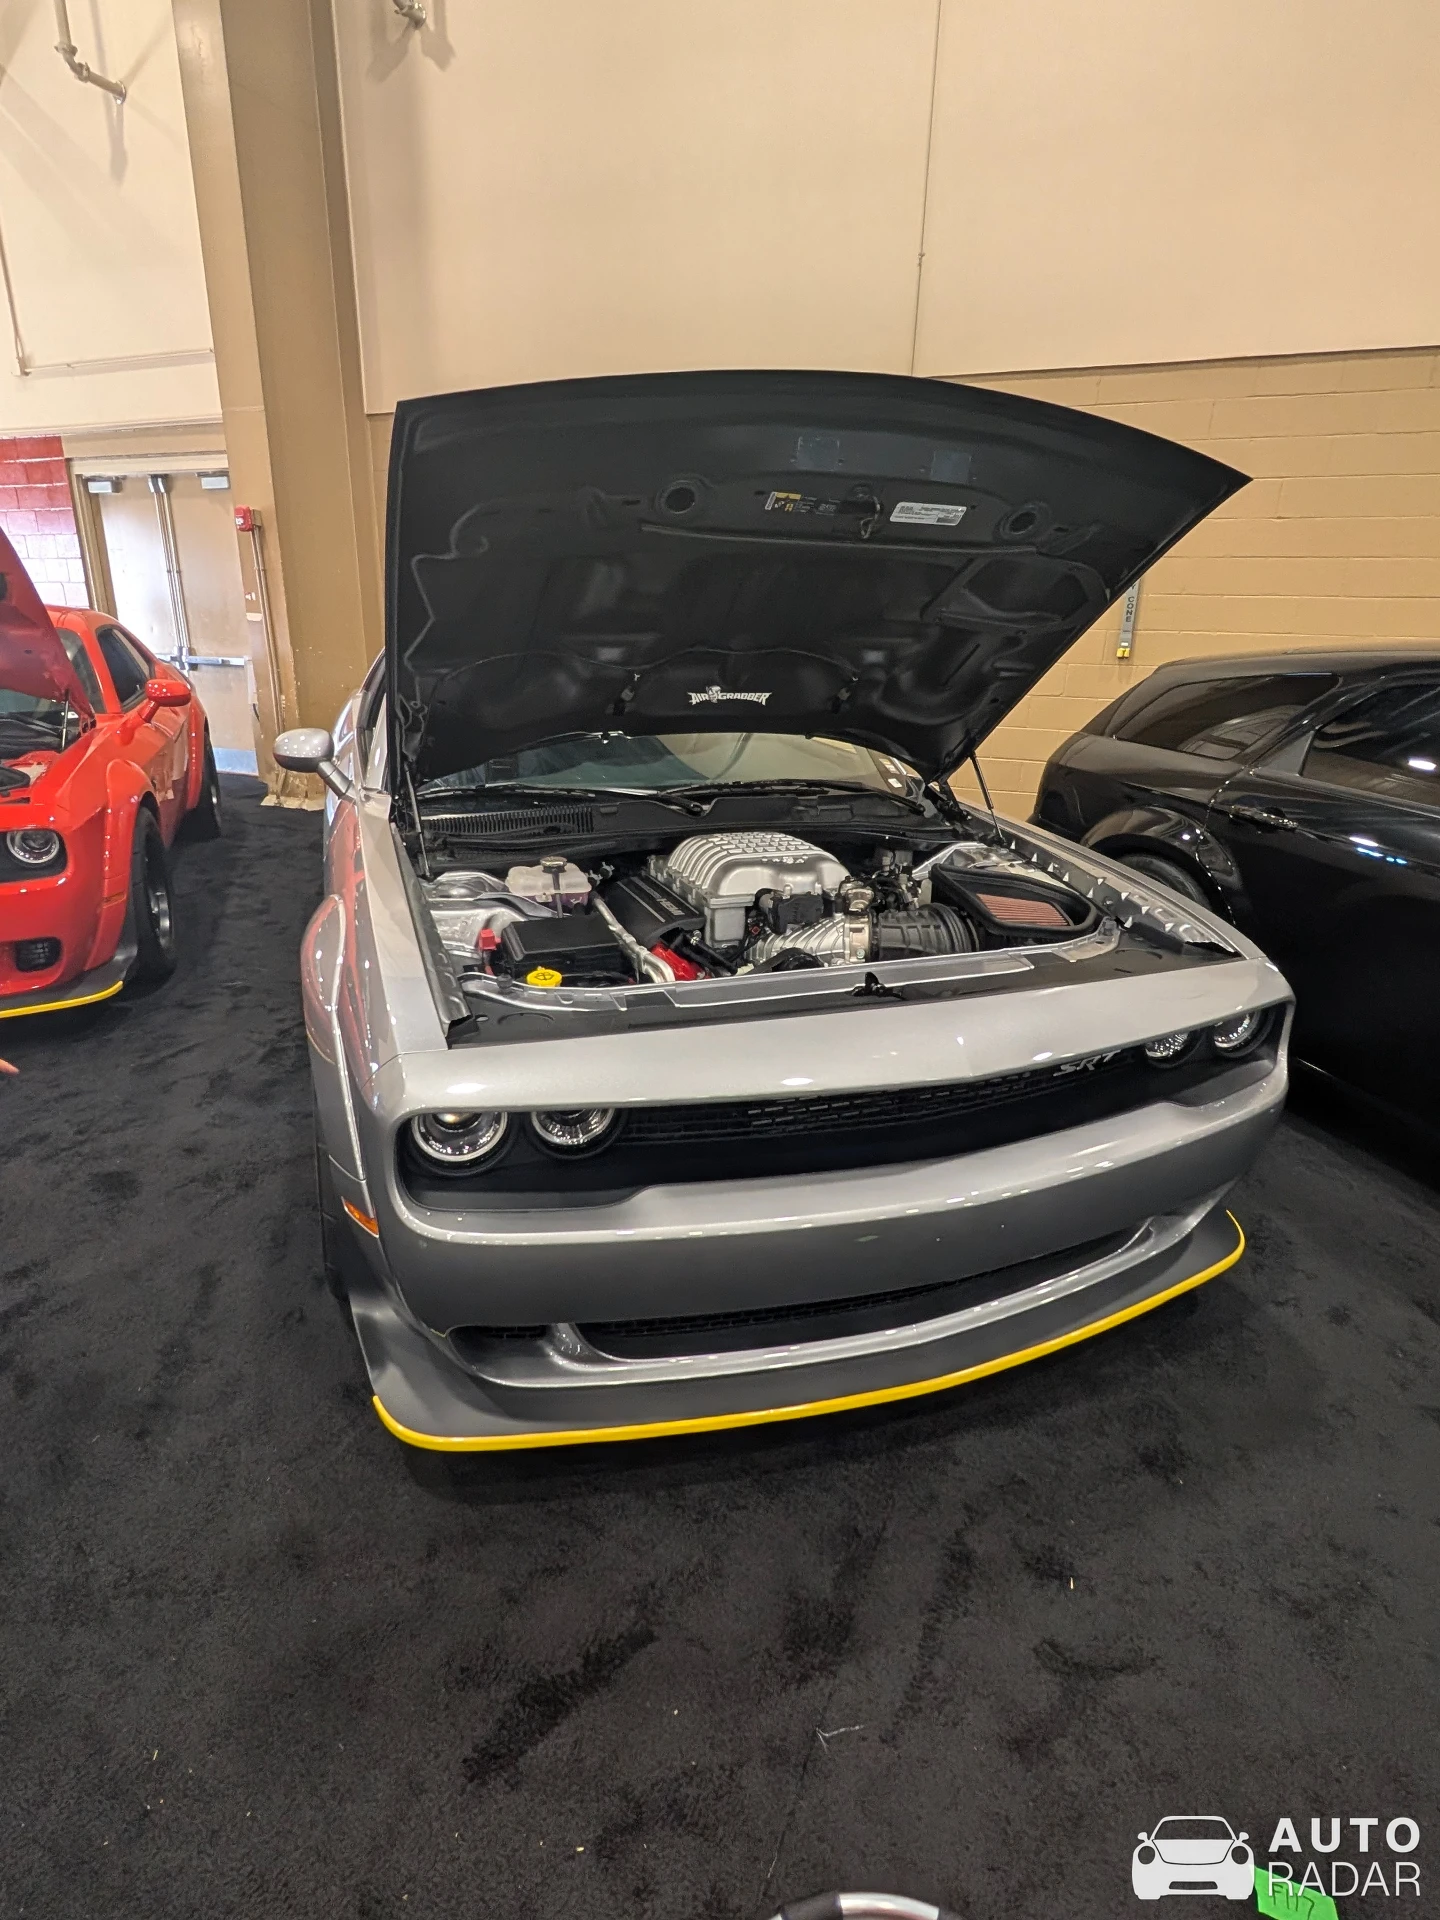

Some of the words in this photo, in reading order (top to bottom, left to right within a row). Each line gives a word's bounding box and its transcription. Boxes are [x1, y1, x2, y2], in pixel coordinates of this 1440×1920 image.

[1126, 596, 1135, 622] CONE
[687, 692, 709, 705] AIR
[1052, 1048, 1122, 1077] SRT
